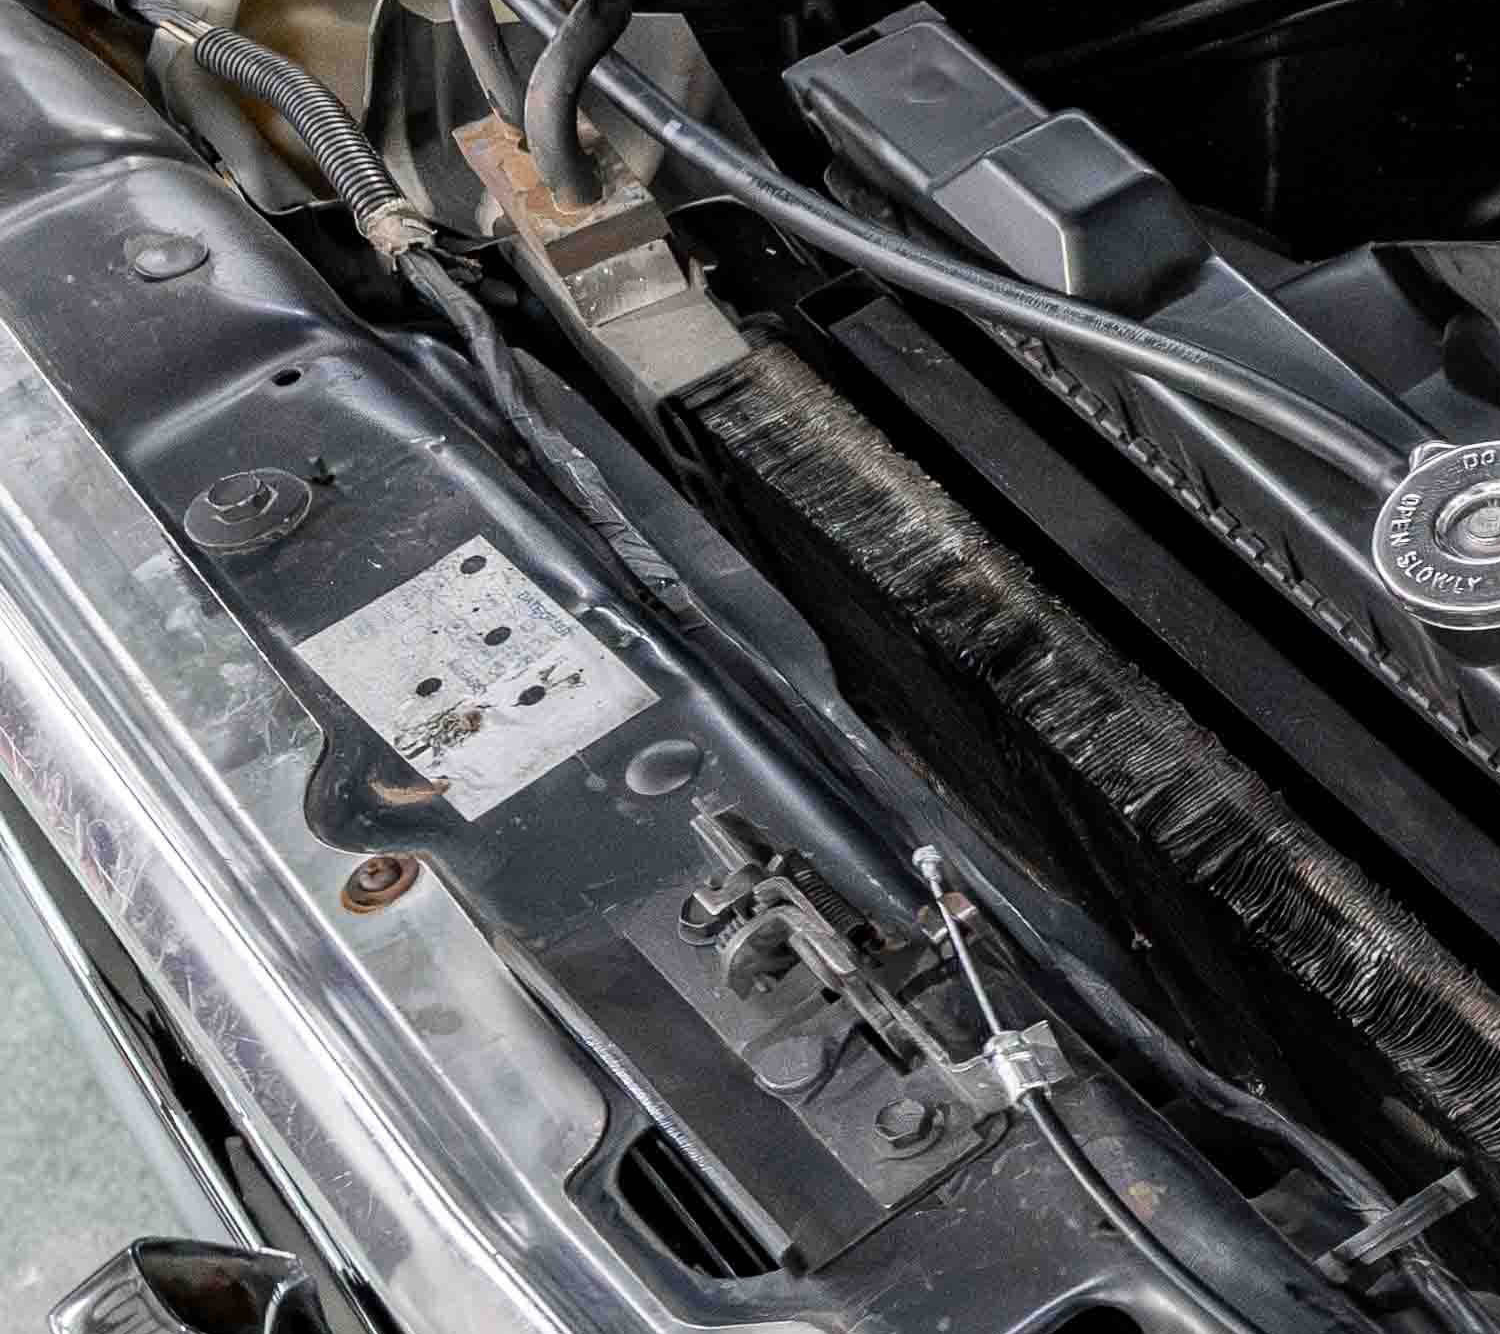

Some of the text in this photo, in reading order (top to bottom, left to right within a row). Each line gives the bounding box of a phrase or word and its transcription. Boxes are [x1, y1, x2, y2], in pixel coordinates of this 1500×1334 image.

[1462, 449, 1496, 469] DO
[1390, 492, 1482, 595] OPEN SLOWLY
